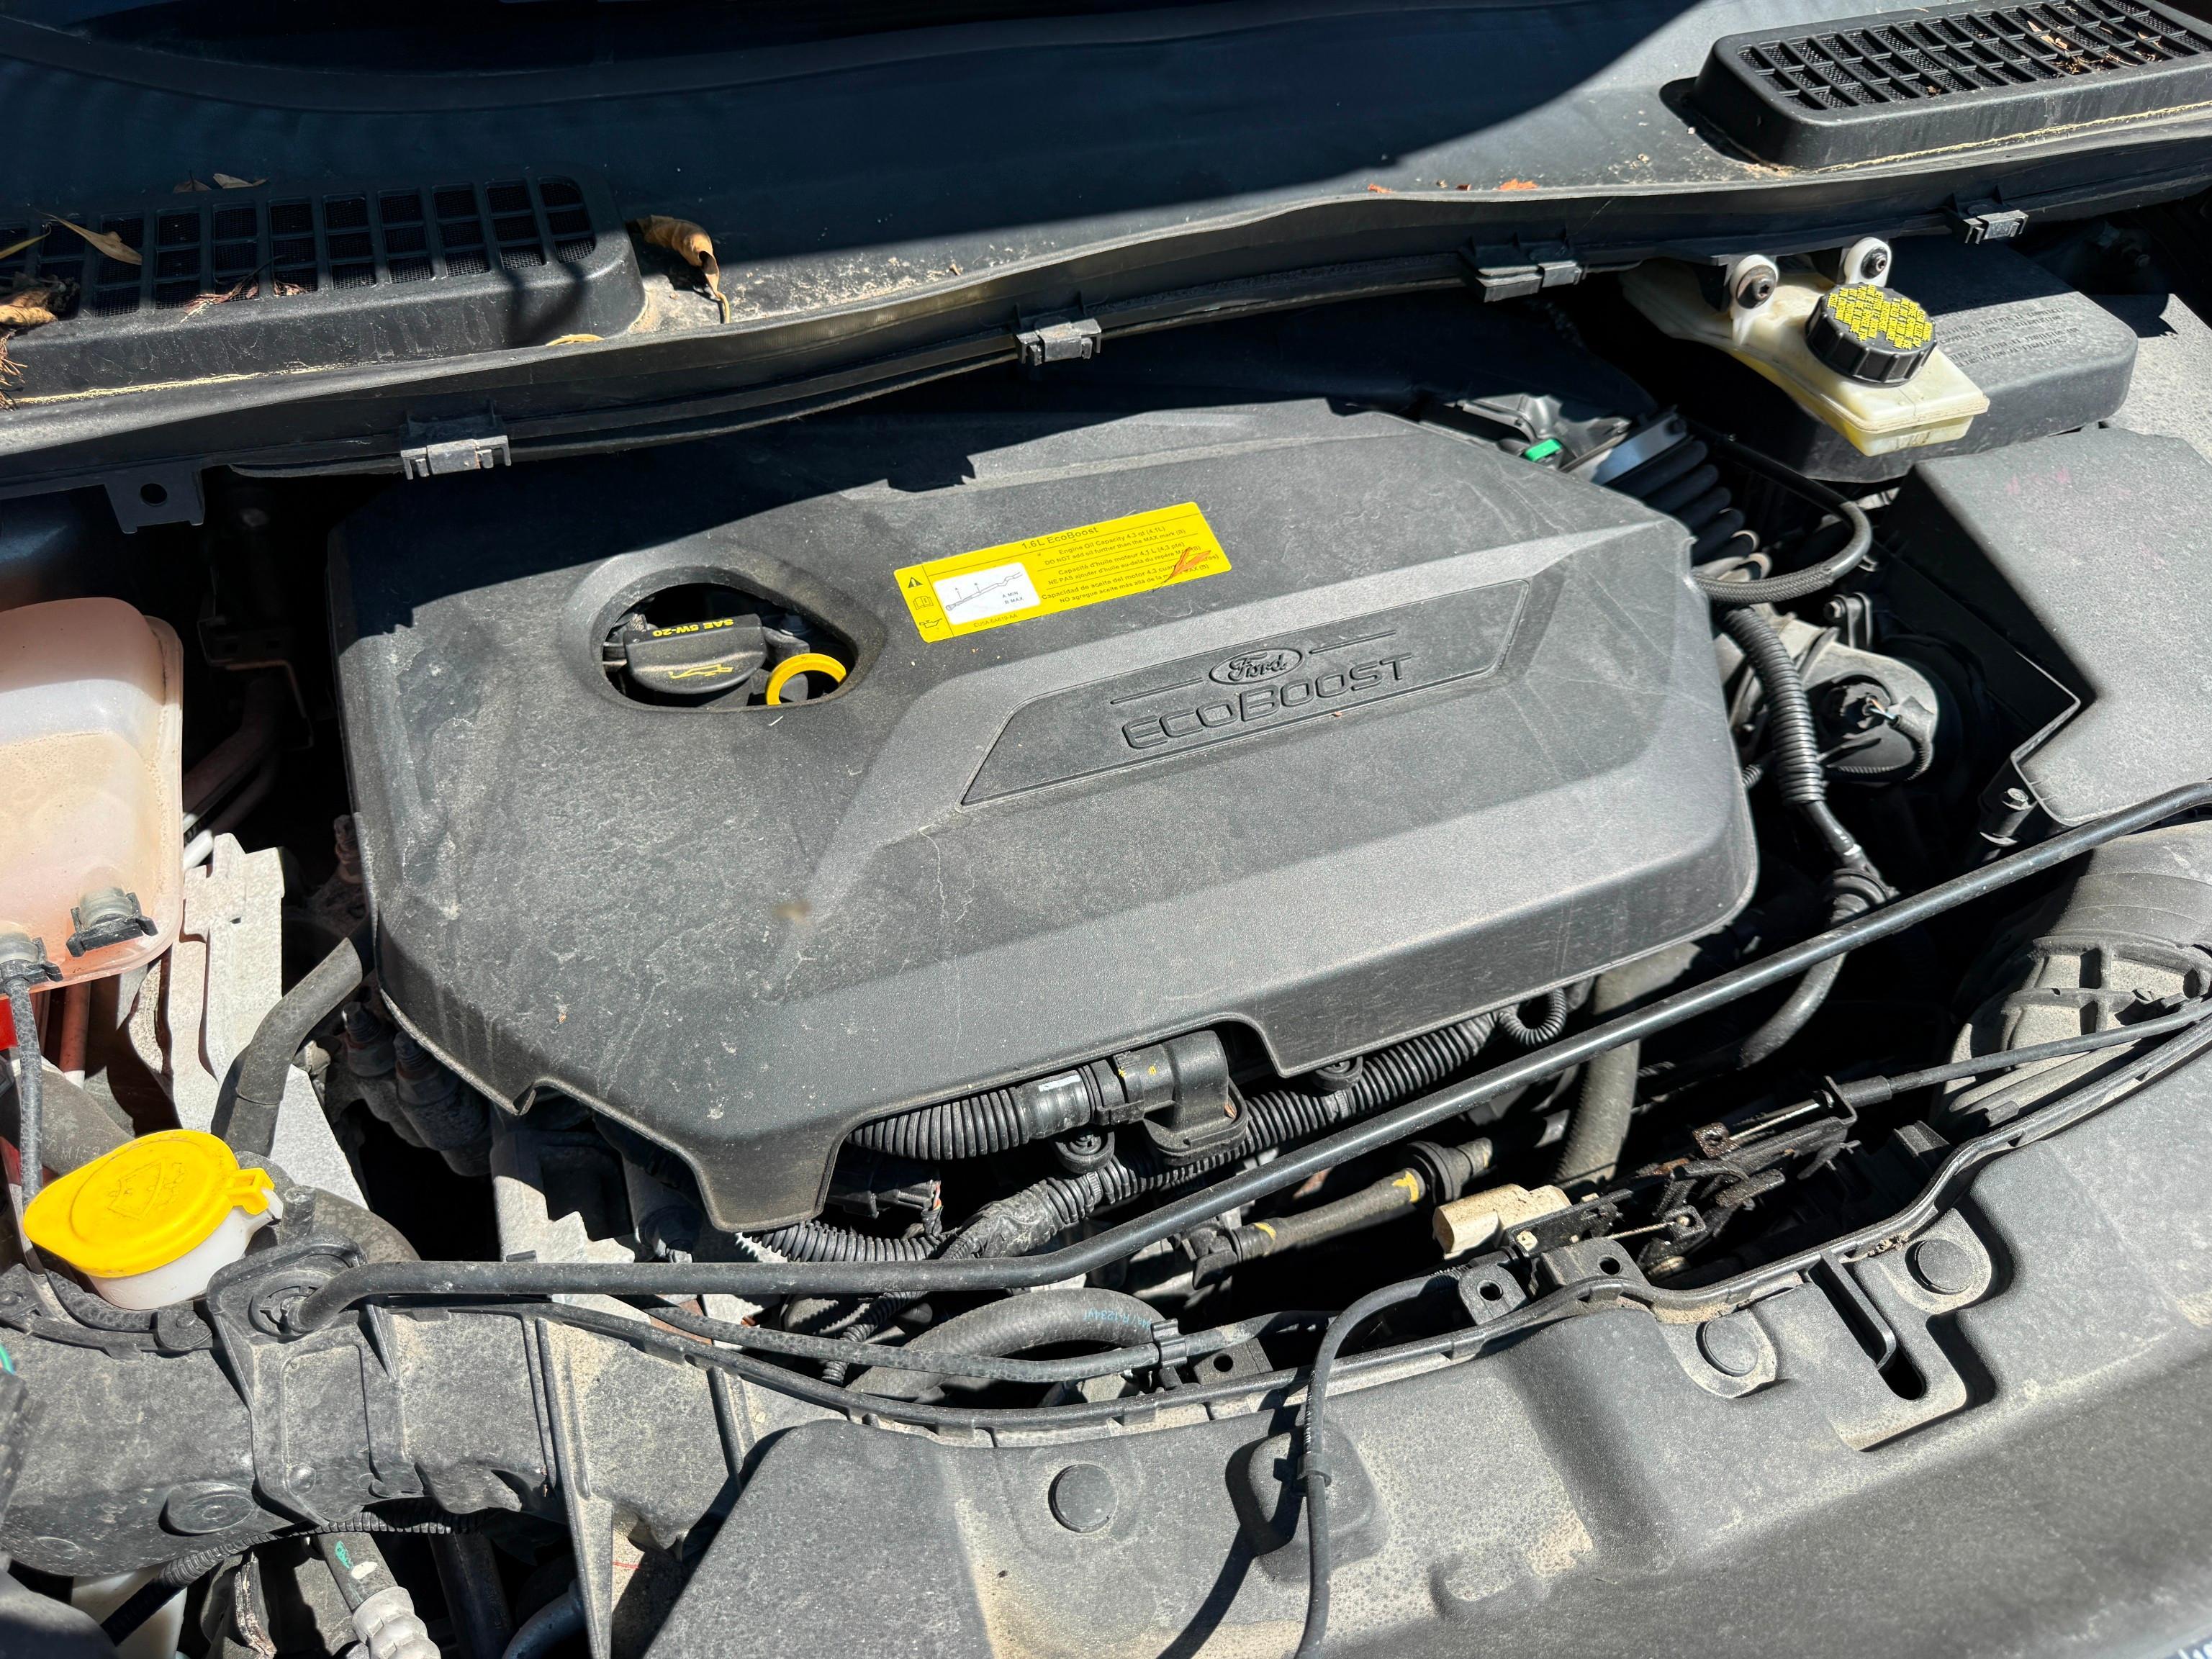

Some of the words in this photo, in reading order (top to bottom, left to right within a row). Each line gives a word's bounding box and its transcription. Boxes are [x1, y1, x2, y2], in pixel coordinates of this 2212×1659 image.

[1021, 538, 1045, 549] 1.6L
[1046, 526, 1098, 543] EcoBoost
[1058, 545, 1083, 555] Engine
[1095, 535, 1125, 546] Capacity
[1093, 545, 1116, 553] further
[1088, 558, 1113, 568] d'huile
[1113, 552, 1139, 561] moteur
[1074, 569, 1098, 579] ajouter
[1097, 564, 1120, 573] d'huile
[1042, 587, 1079, 600] Capacidad
[1090, 579, 1111, 588] aceite
[1124, 571, 1147, 579] motor
[1070, 590, 1098, 601] agregue
[1098, 585, 1119, 594] aceite
[652, 623, 700, 637] 5W-20
[703, 618, 734, 630] SAE
[1227, 652, 1288, 682] Ford
